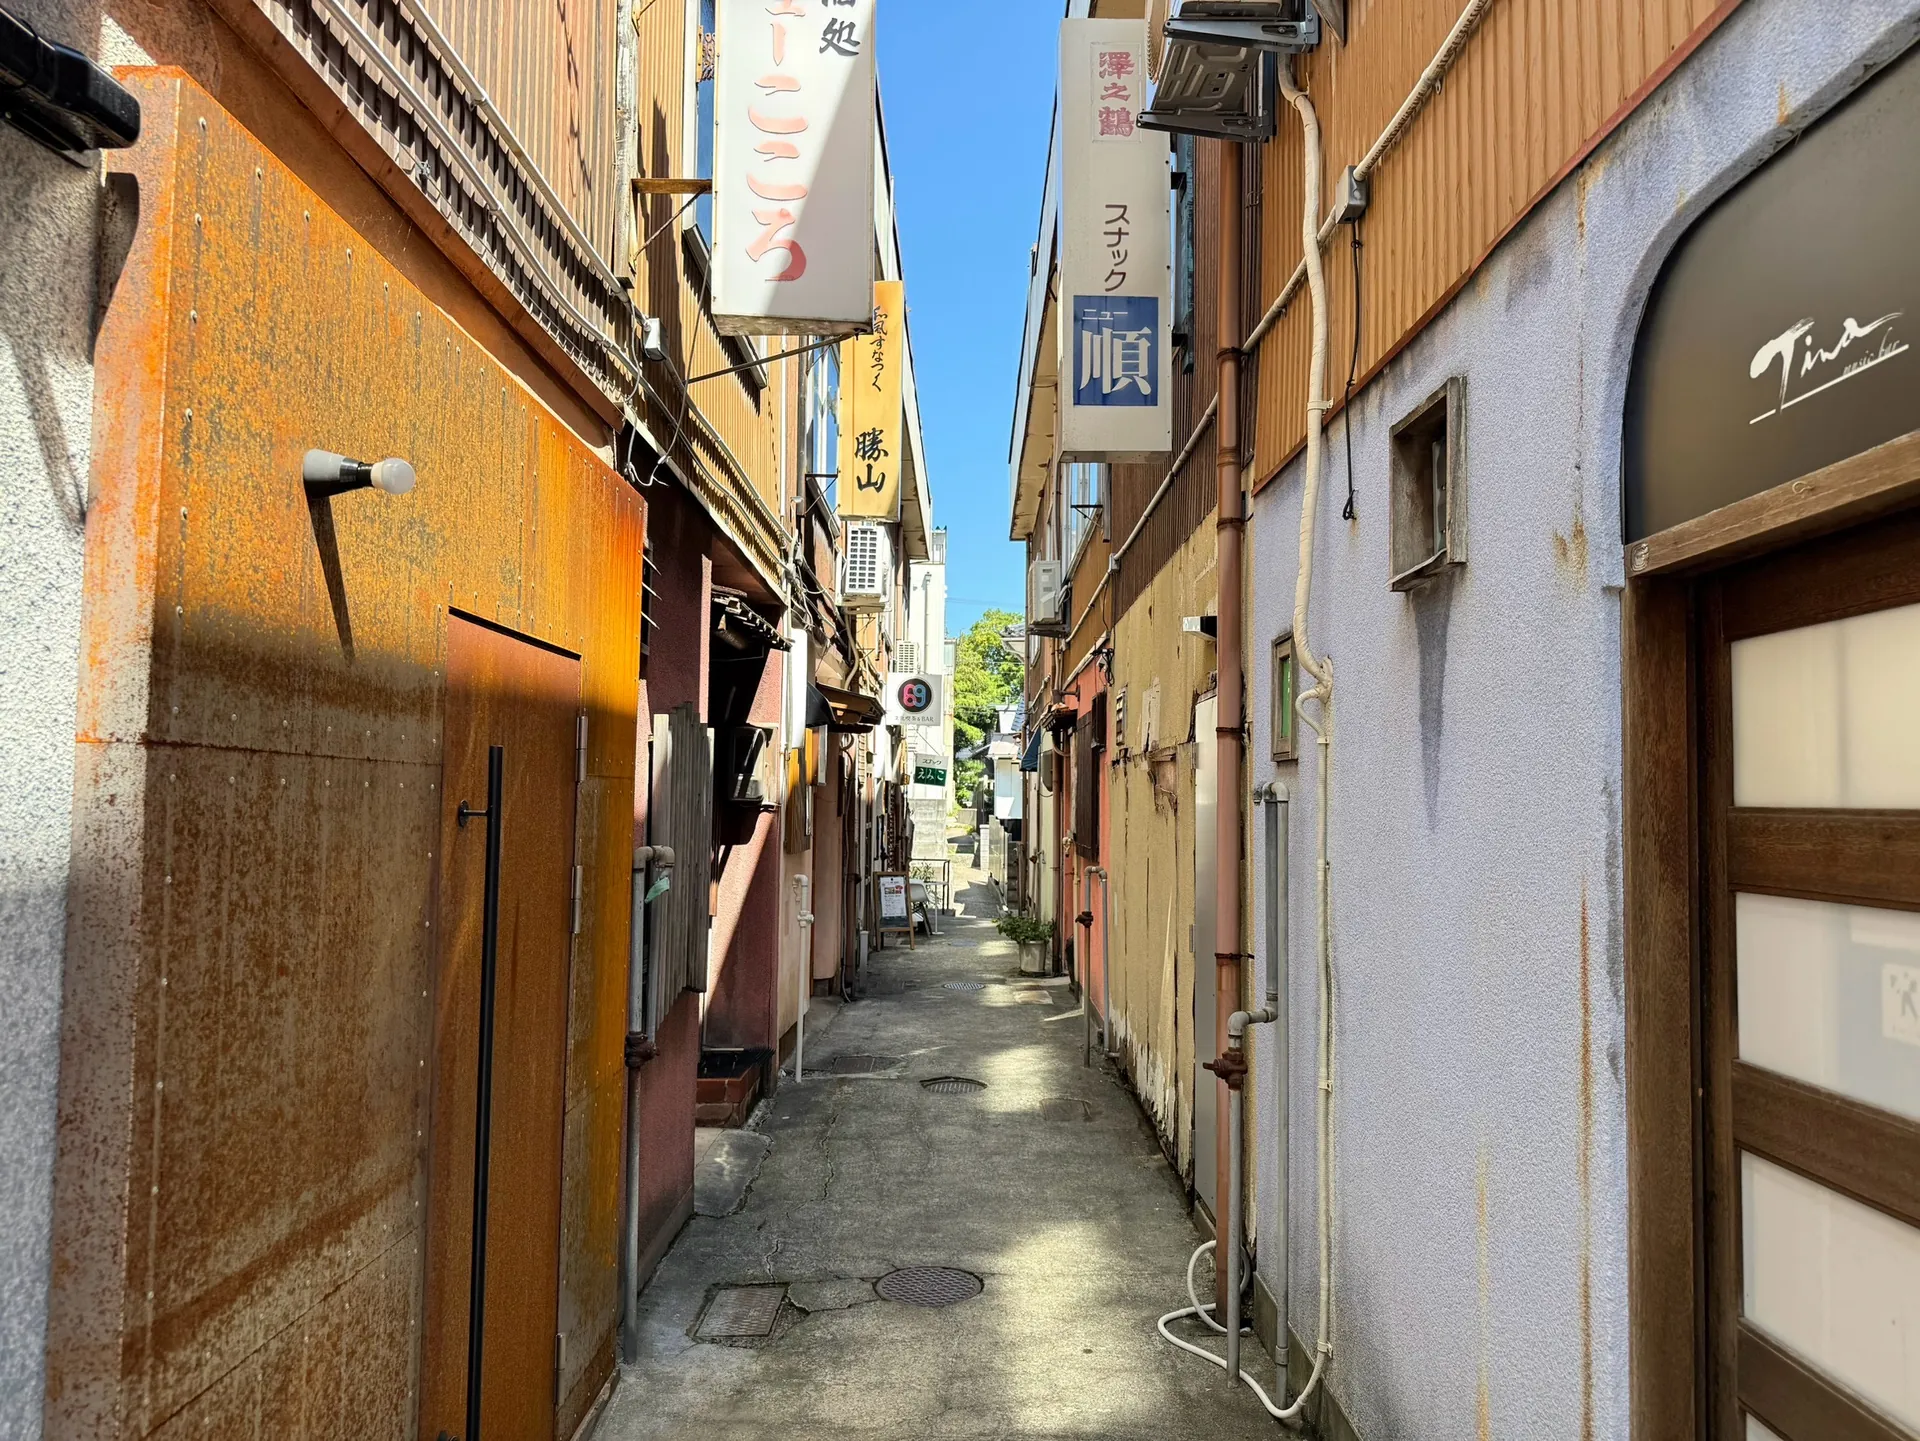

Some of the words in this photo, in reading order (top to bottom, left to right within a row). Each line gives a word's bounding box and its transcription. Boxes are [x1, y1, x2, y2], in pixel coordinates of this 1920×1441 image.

[1098, 51, 1135, 137] 澤之鶴
[1103, 204, 1130, 292] スナック
[1082, 308, 1128, 321] ニュー
[1079, 326, 1152, 396] 順
[1750, 312, 1904, 414] Tina
[854, 427, 889, 493] 勝山
[903, 683, 926, 707] 69
[917, 767, 945, 781] えみこ
